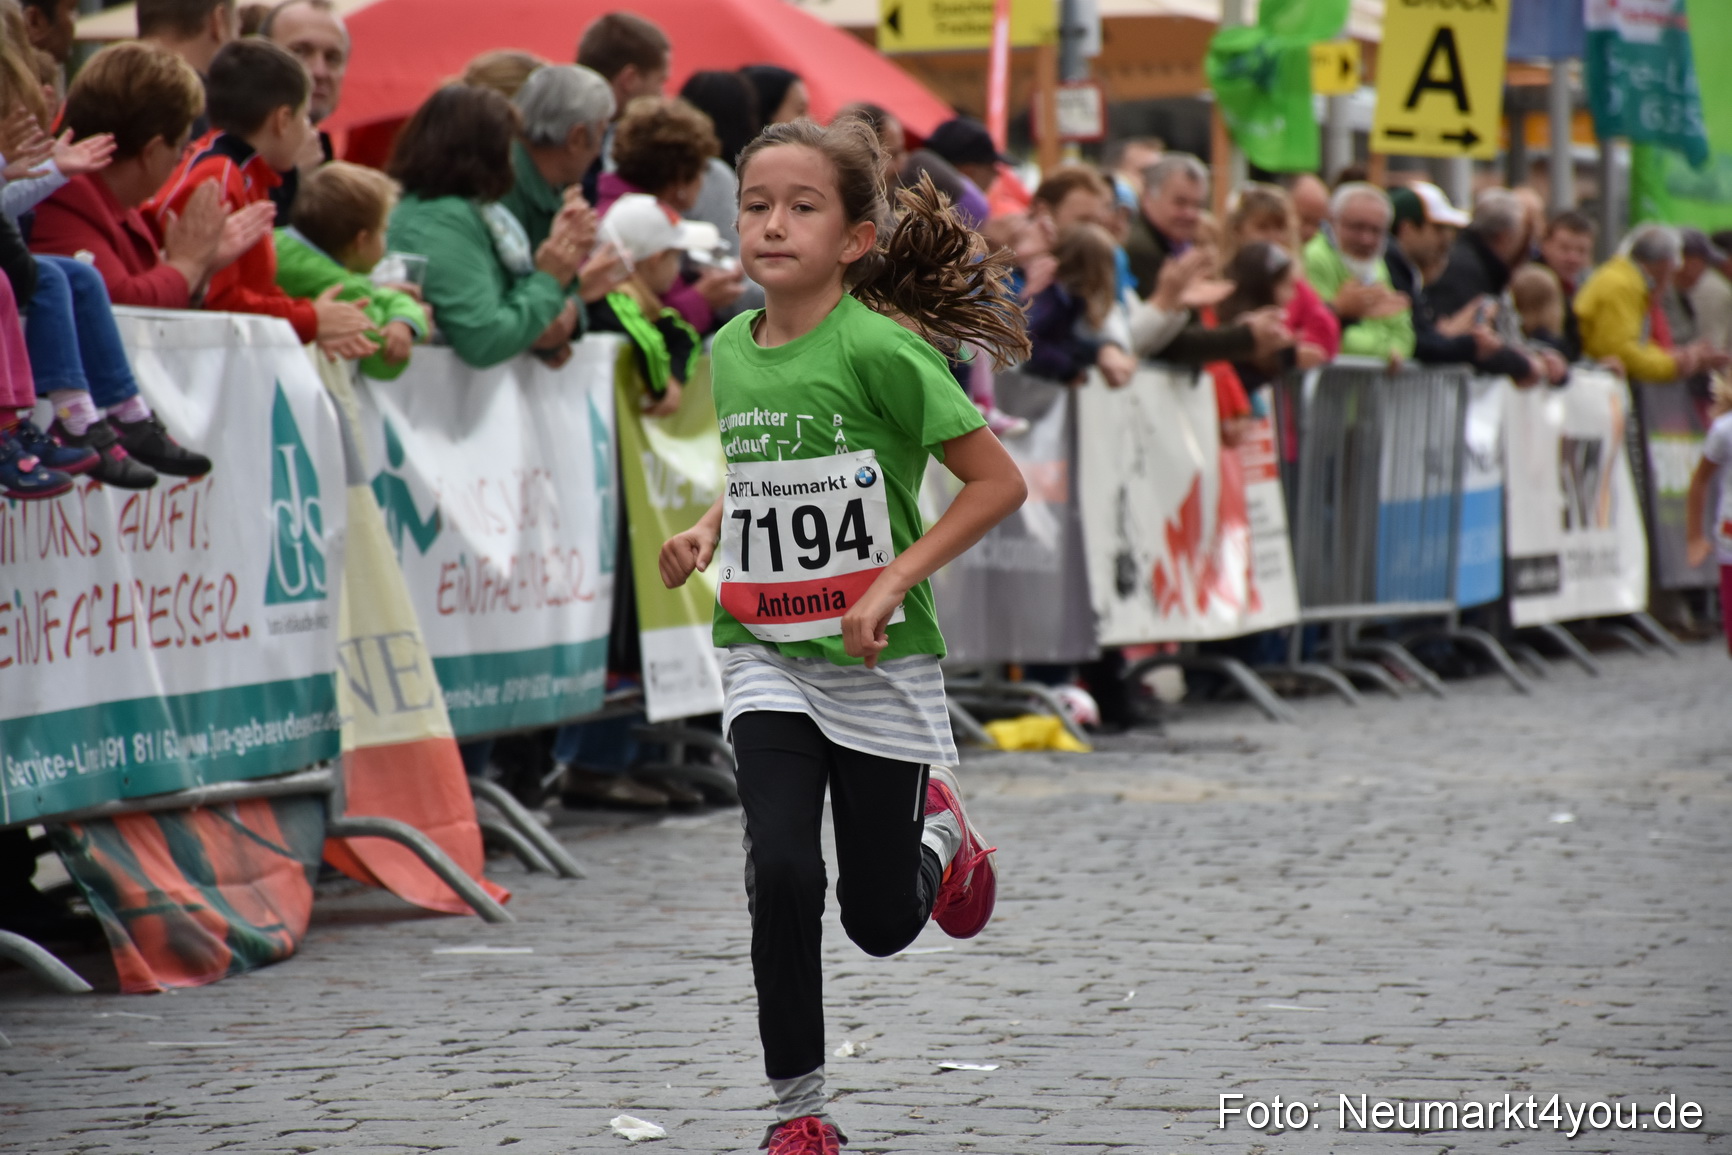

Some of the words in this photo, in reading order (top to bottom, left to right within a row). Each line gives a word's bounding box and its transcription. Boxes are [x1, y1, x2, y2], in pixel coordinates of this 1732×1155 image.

[1404, 25, 1472, 114] A
[719, 407, 788, 433] eumarkter
[728, 481, 759, 498] ARTL
[762, 475, 848, 497] Neumarkt
[731, 498, 874, 573] 7194
[875, 552, 884, 564] K
[724, 567, 732, 580] 3
[756, 587, 847, 618] Antonia
